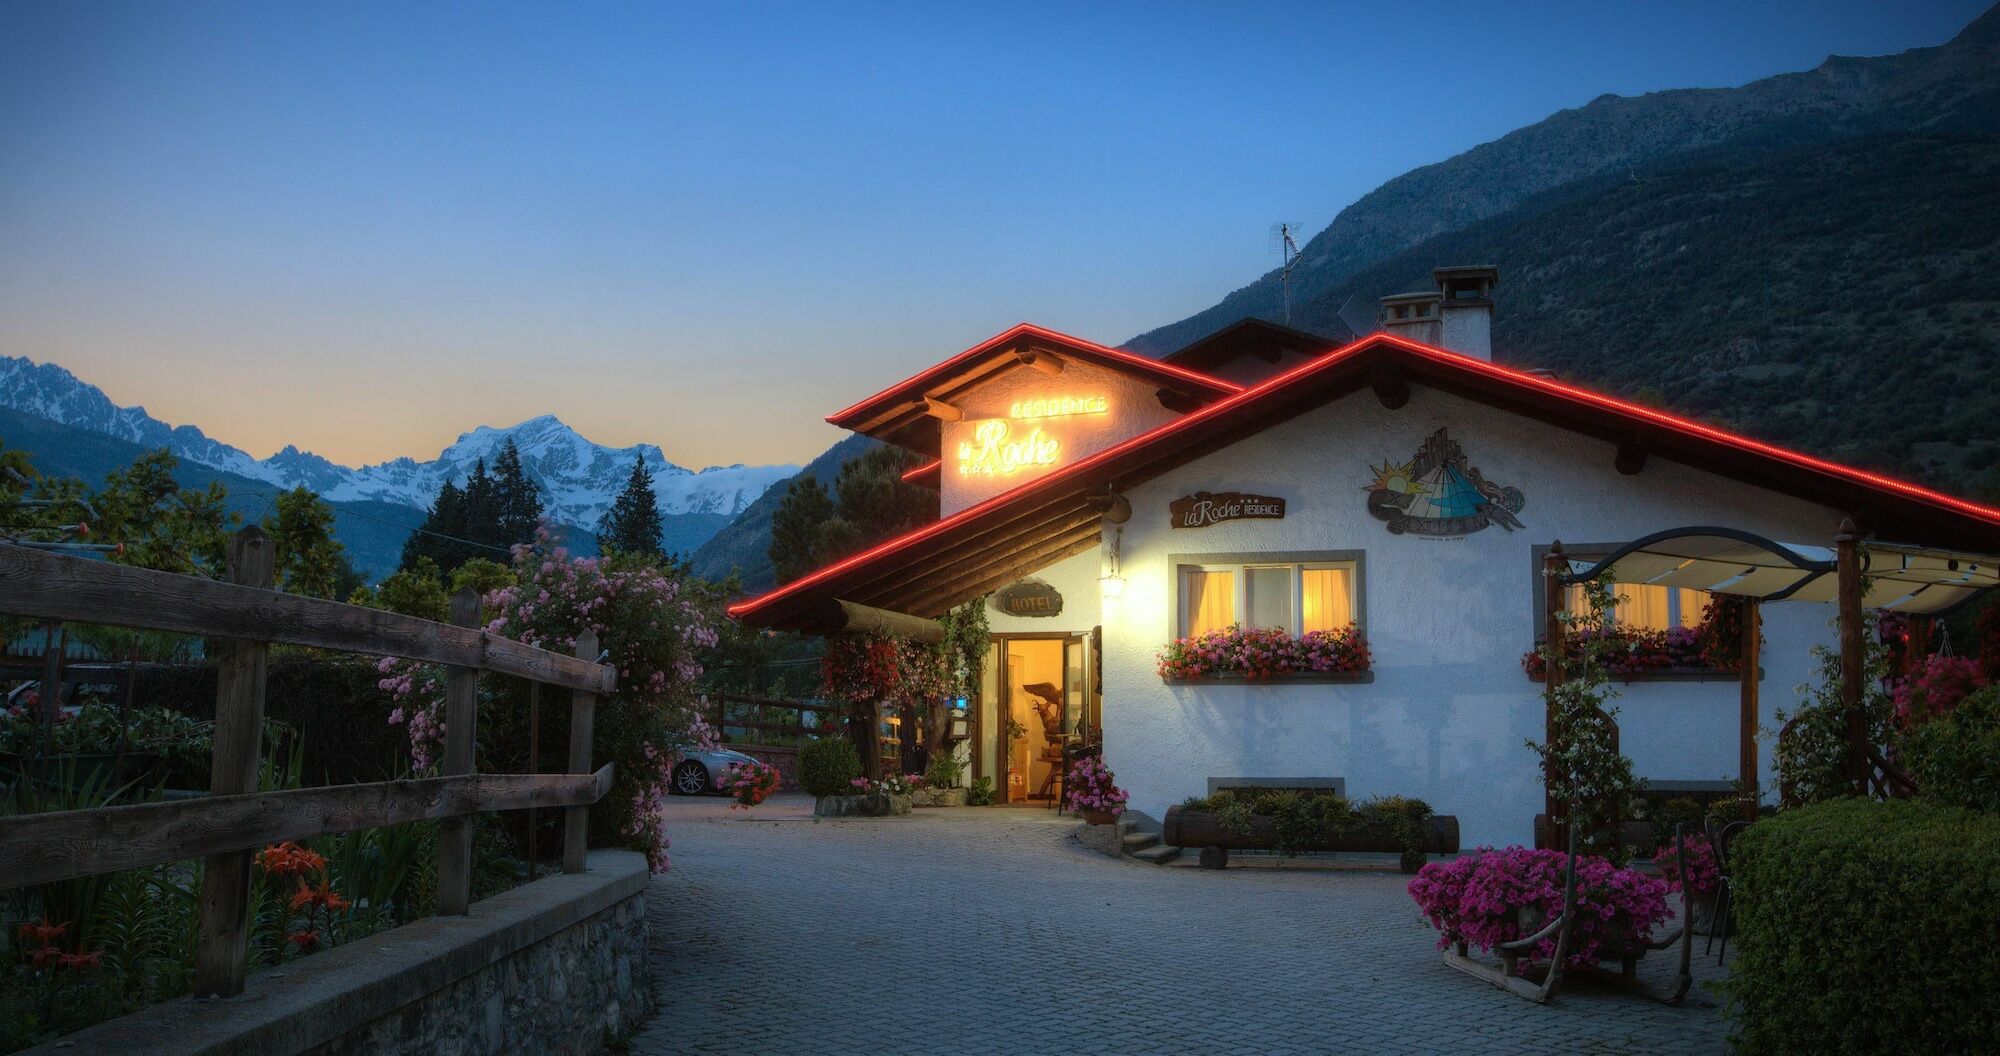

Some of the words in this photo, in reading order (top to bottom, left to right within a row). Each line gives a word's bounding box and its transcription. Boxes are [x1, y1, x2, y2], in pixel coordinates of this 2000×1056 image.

[1011, 397, 1107, 418] RESIDENCE
[976, 419, 1060, 473] Roche
[1244, 504, 1279, 515] RESIDENCE
[1012, 596, 1055, 611] HOTEL
